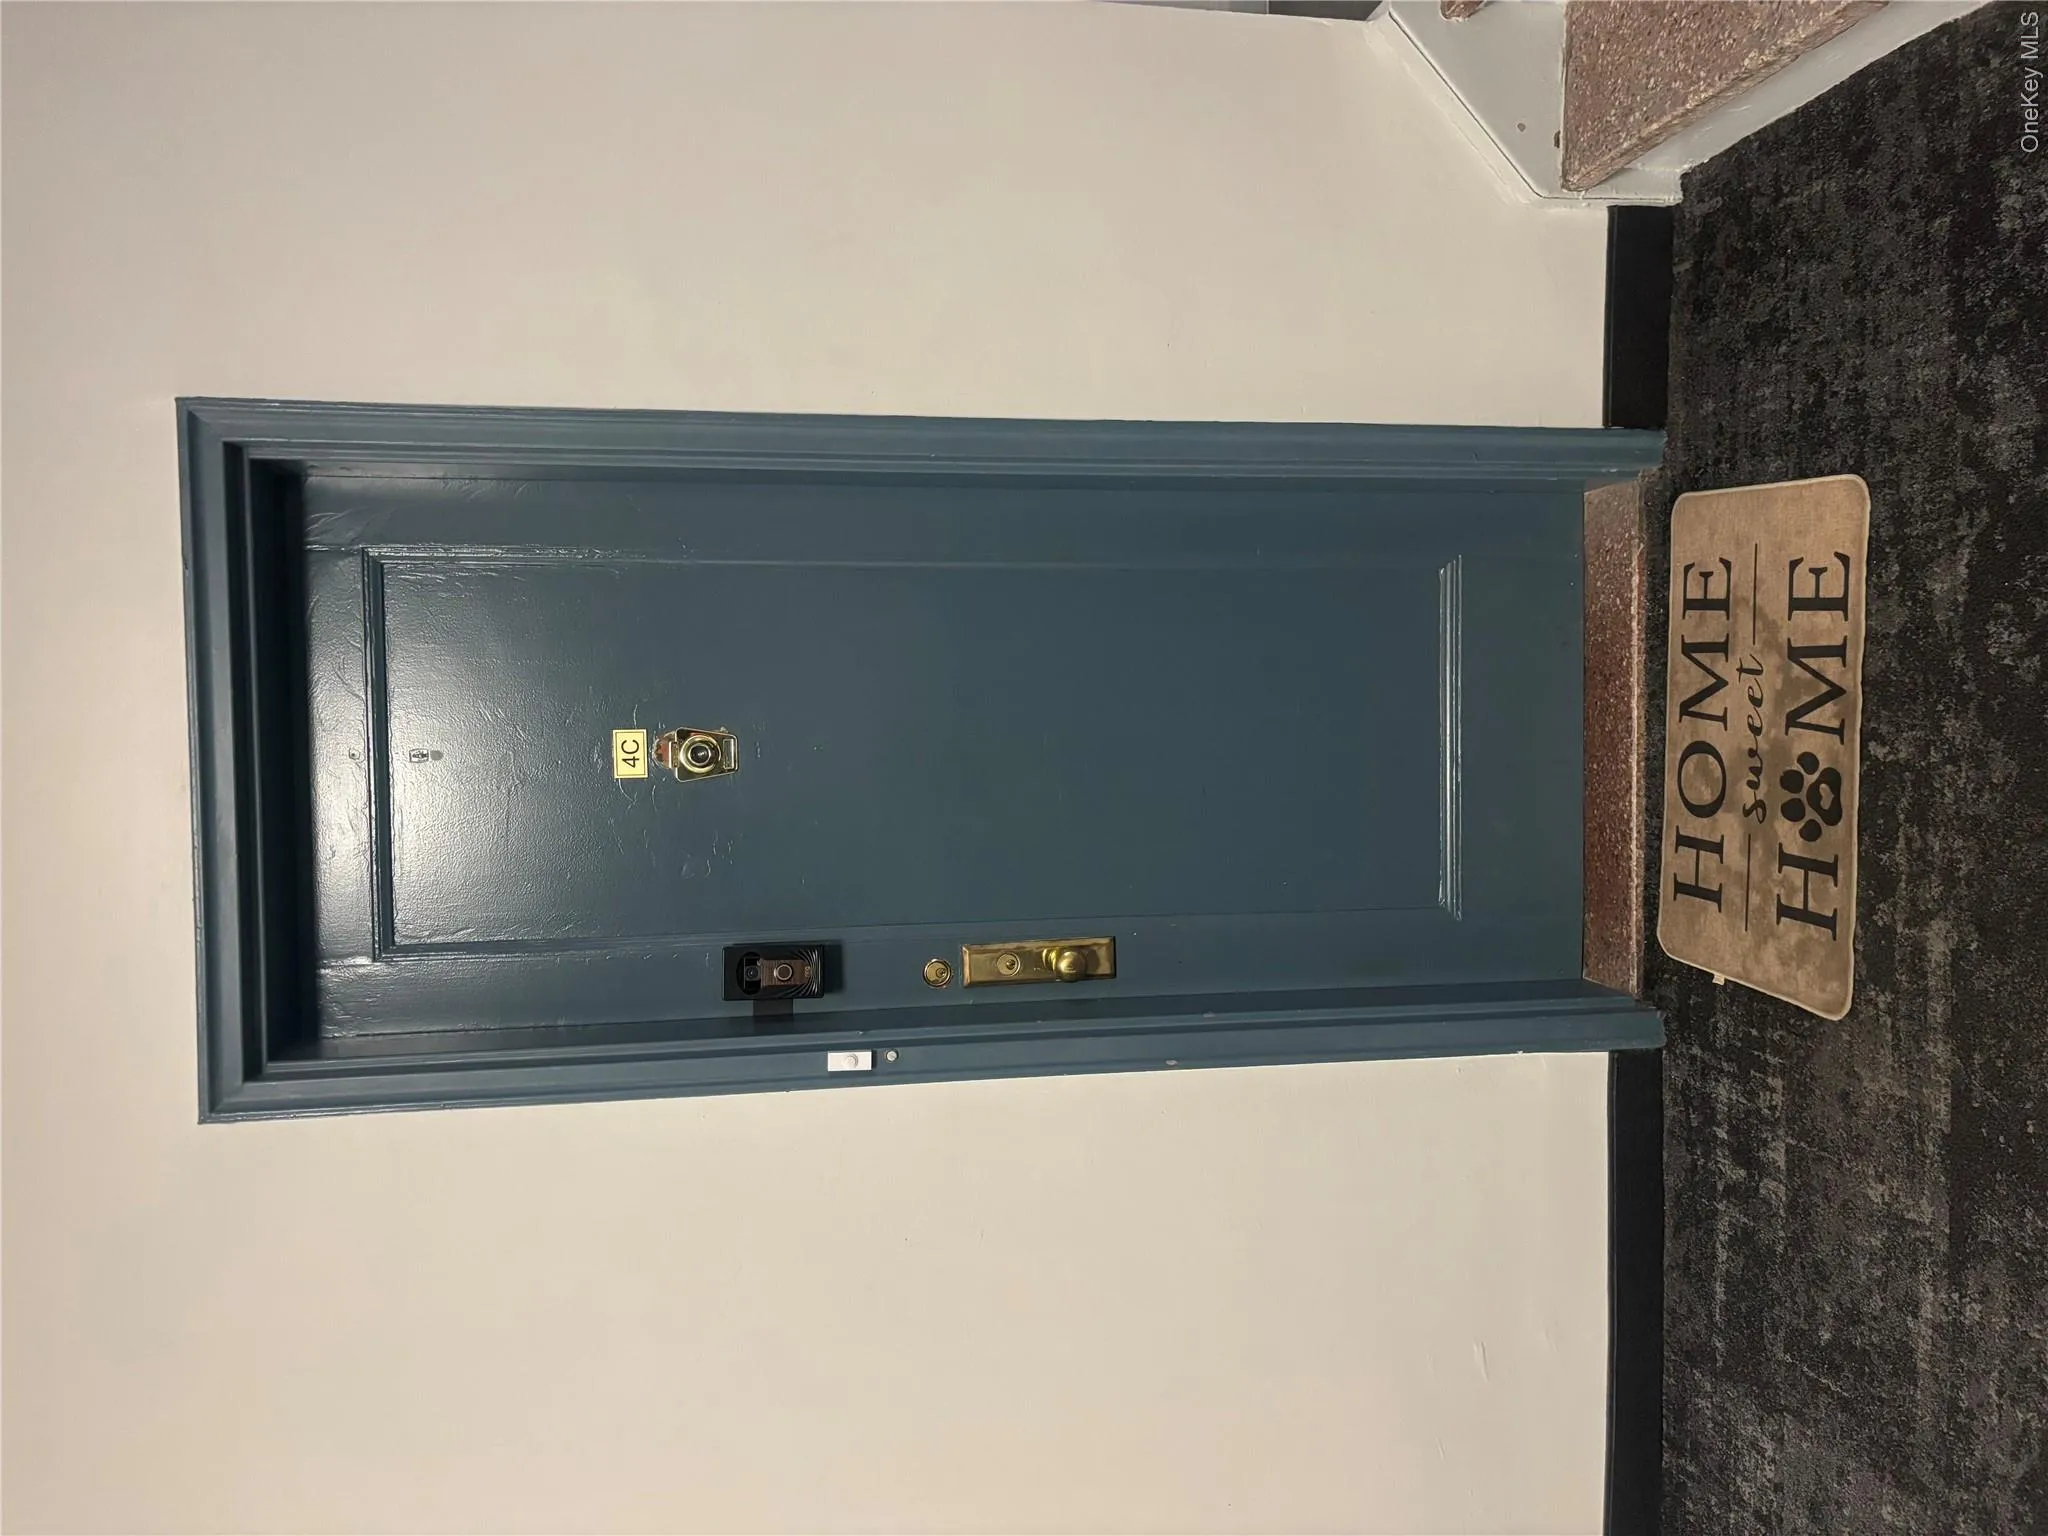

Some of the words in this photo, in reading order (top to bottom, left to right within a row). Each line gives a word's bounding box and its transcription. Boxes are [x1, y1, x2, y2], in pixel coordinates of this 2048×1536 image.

[621, 739, 640, 768] 4C
[1673, 556, 1733, 912] HOME
[1736, 654, 1768, 824] sweet
